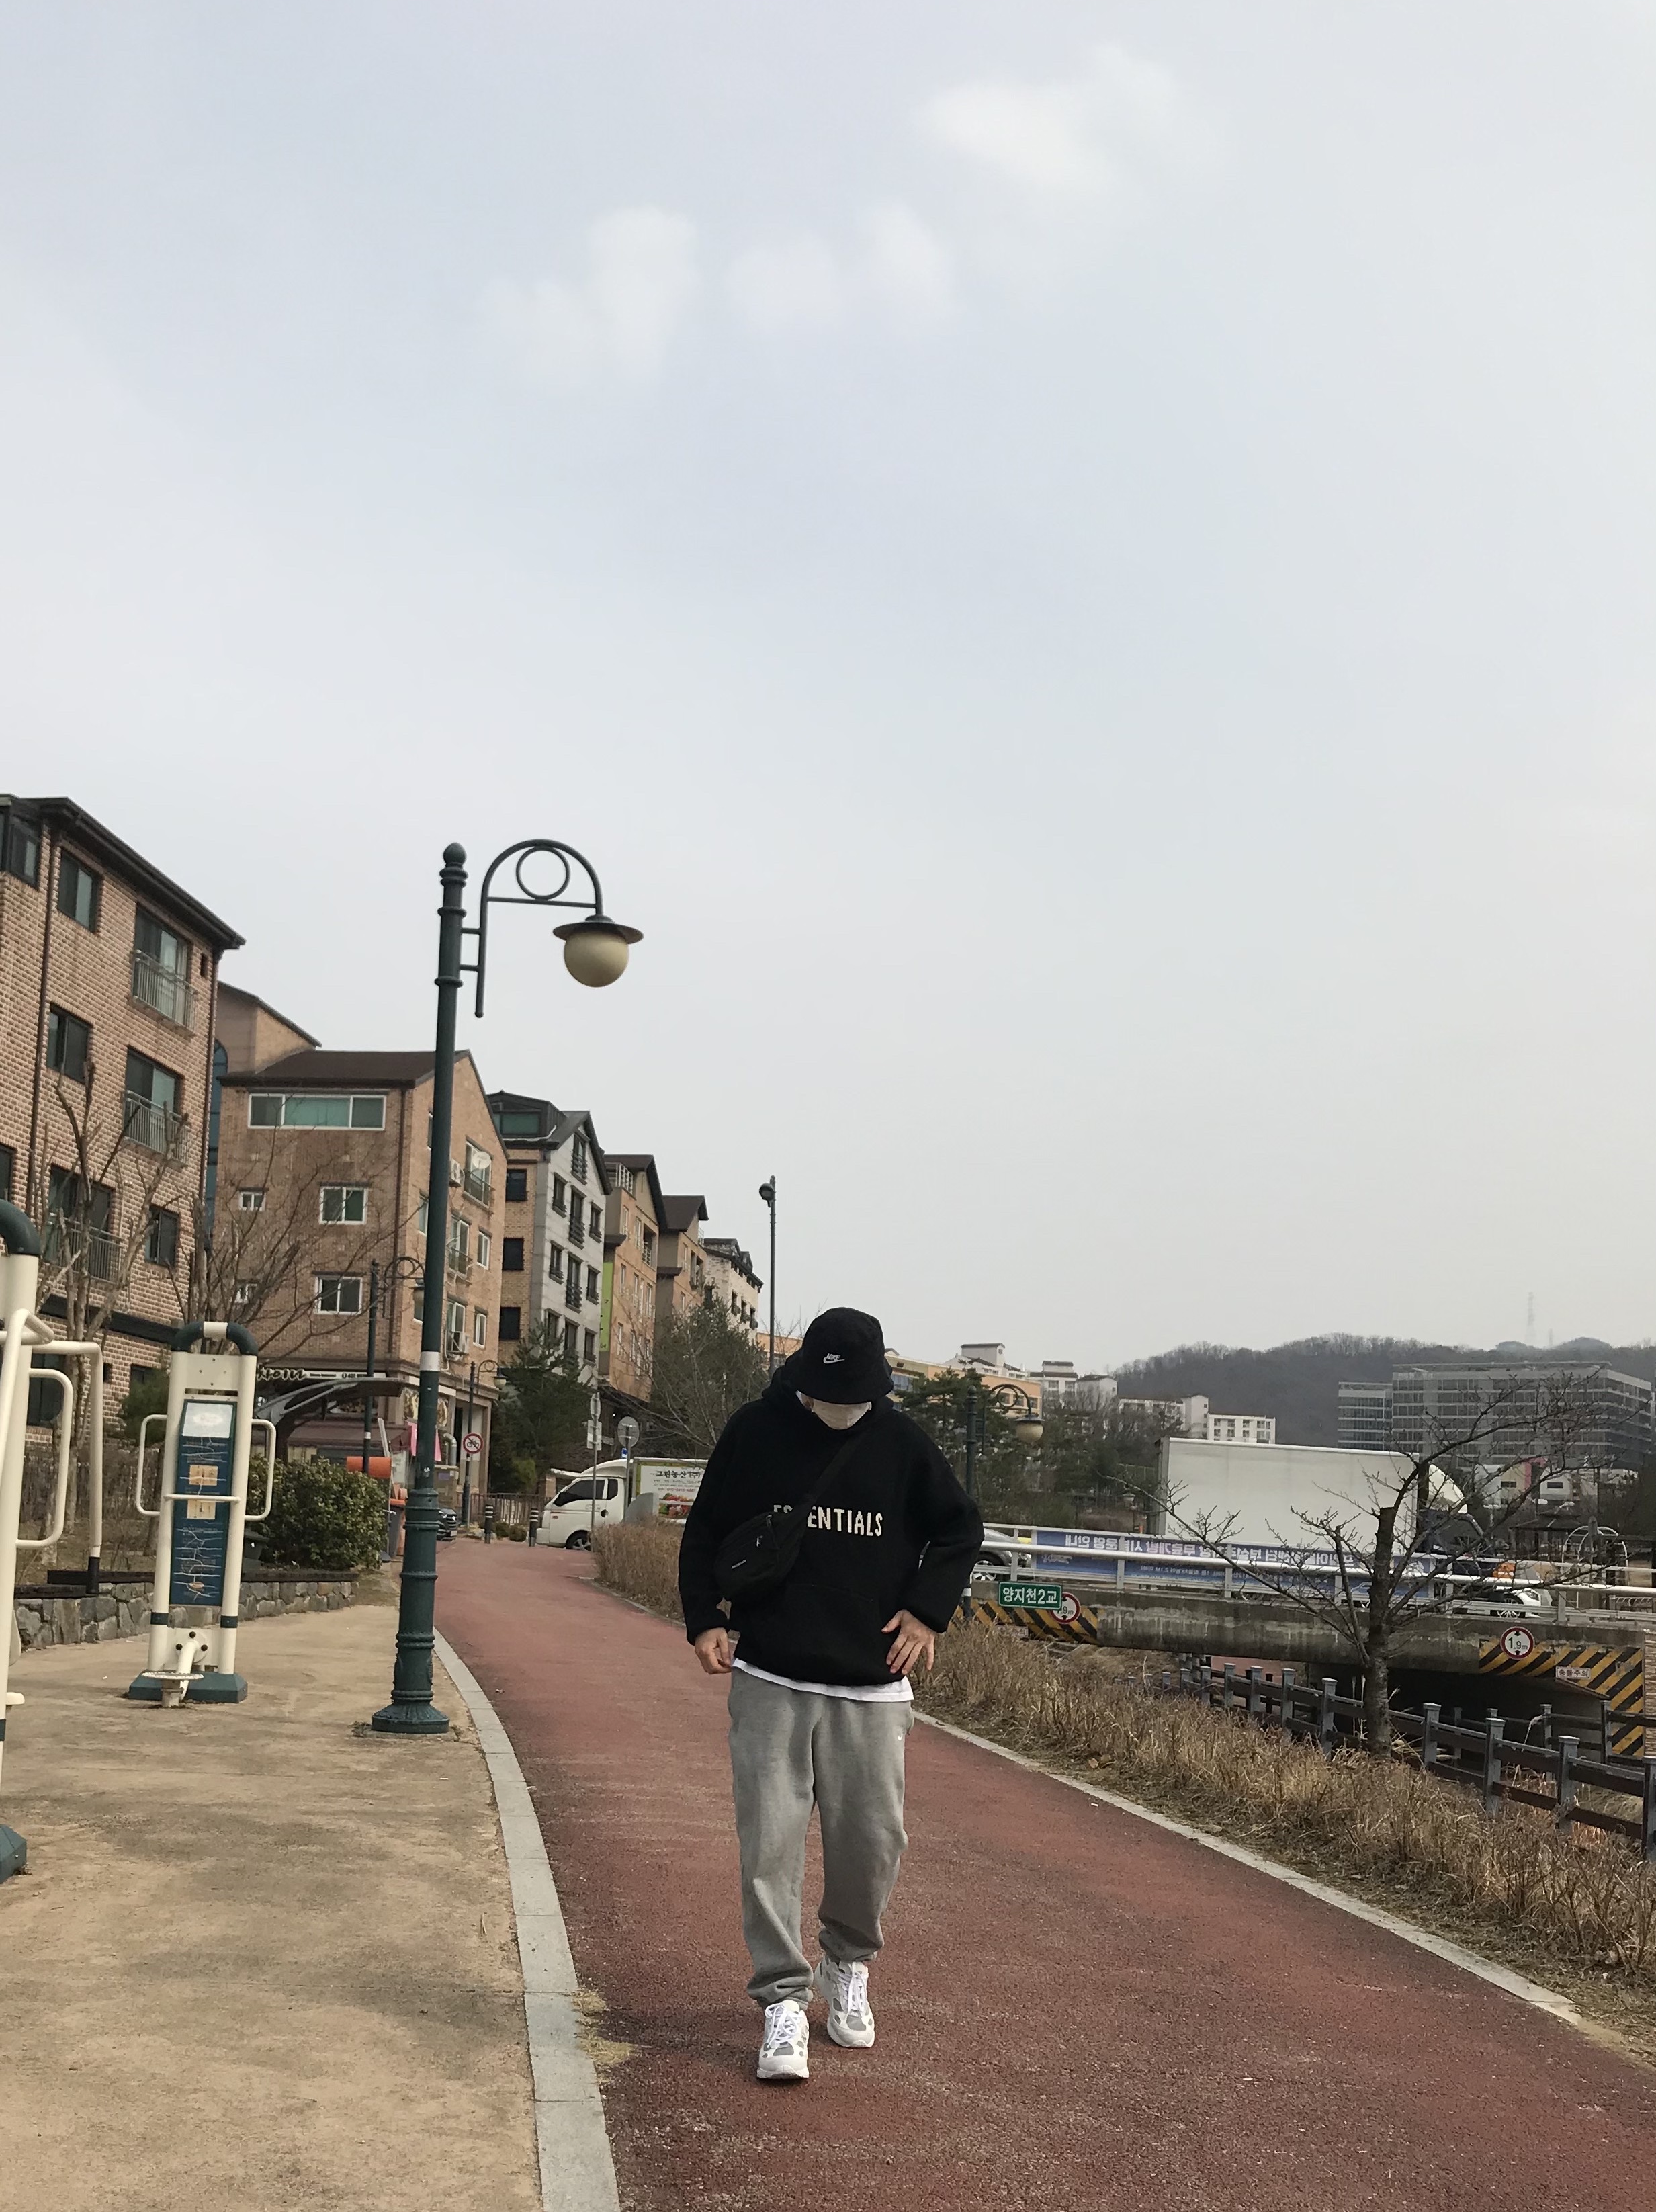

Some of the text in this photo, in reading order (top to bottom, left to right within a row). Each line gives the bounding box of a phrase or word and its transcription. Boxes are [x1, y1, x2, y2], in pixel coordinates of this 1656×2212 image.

[826, 1353, 842, 1361] NIKE
[773, 1504, 884, 1537] ENTIALS
[1002, 1586, 1058, 1605] 양지천2교
[1508, 1637, 1528, 1650] 1.9m
